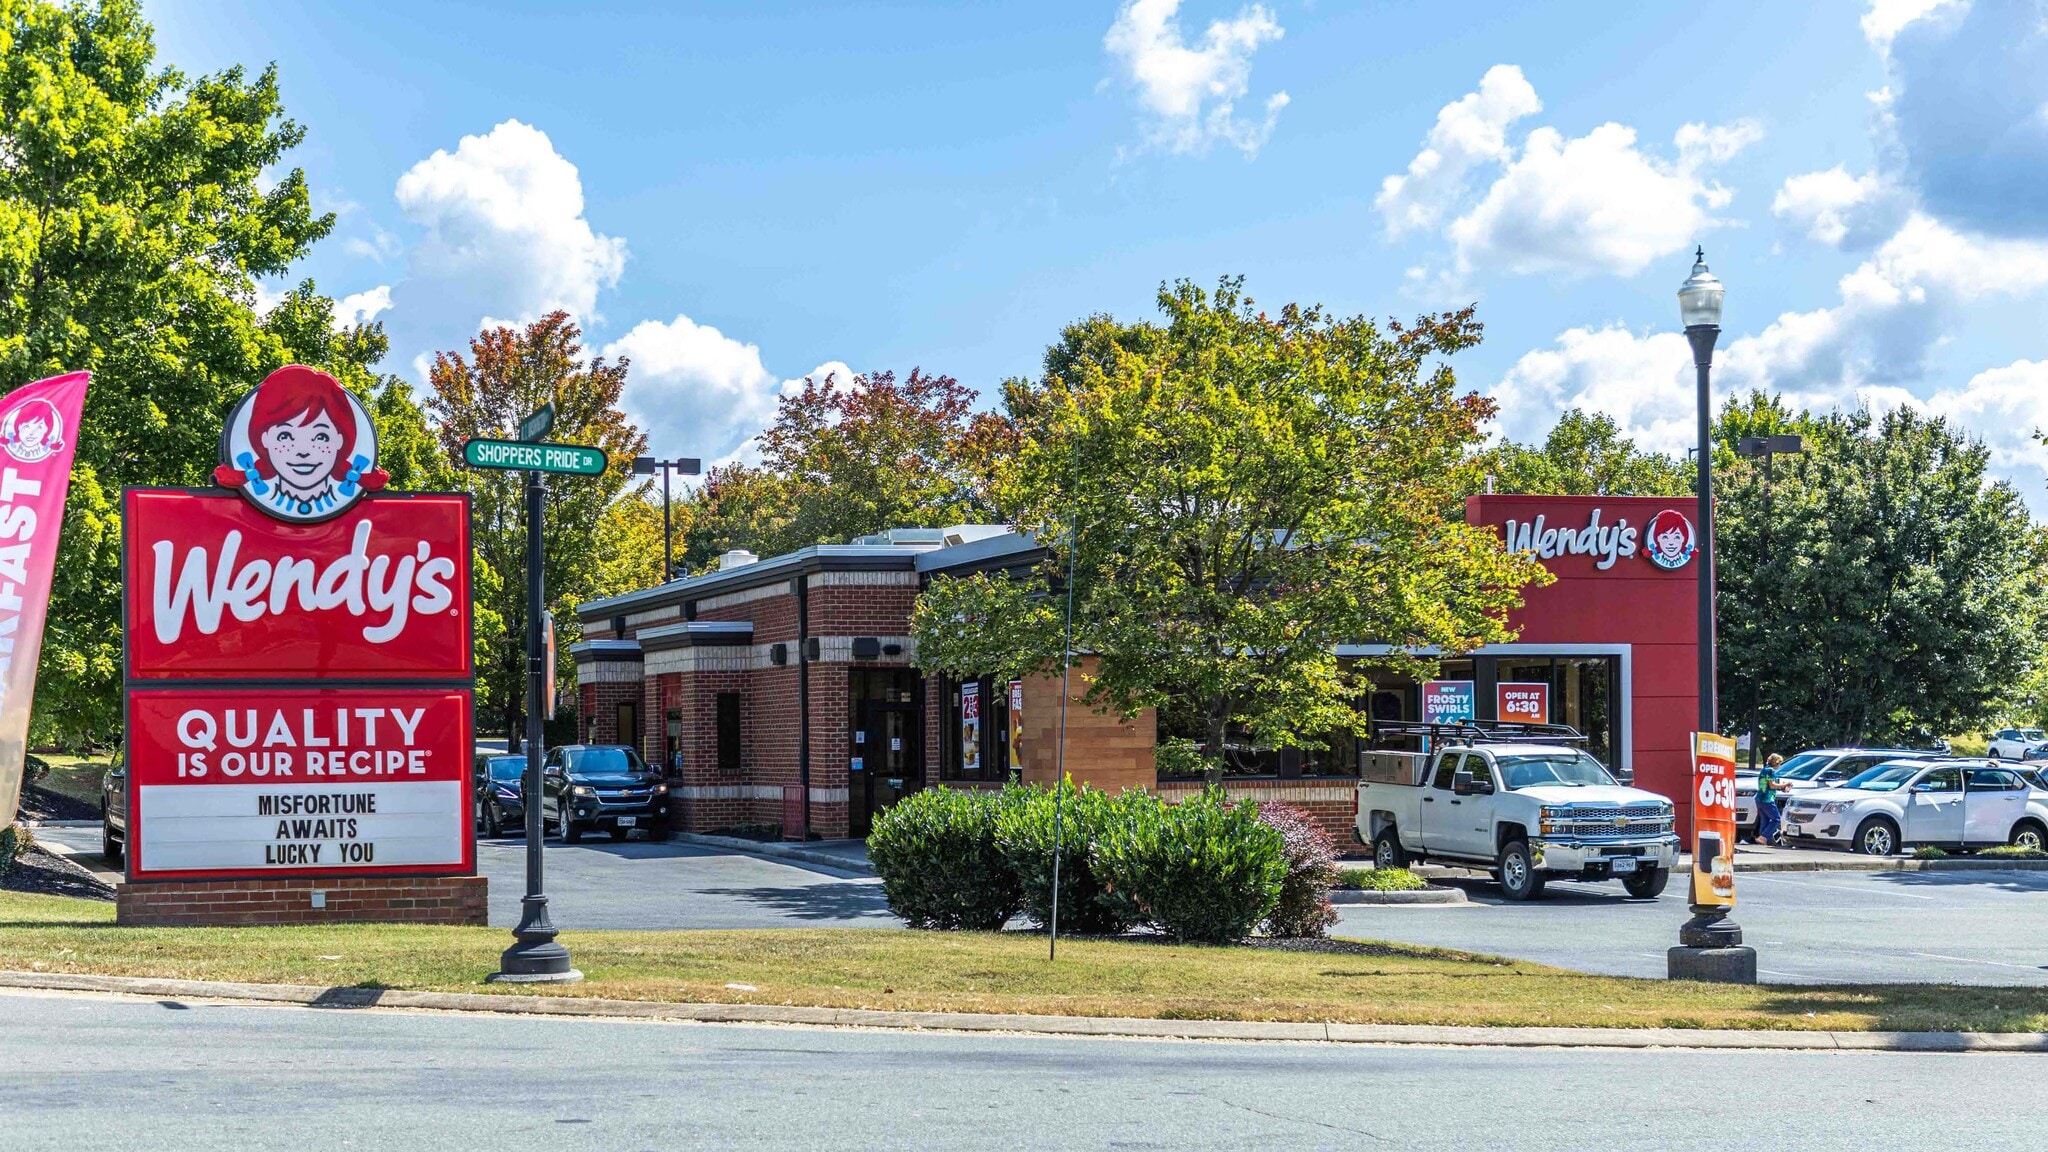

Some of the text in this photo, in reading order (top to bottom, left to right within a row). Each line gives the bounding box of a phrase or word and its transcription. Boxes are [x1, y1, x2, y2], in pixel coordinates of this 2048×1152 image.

[477, 444, 593, 469] SHOPPERS PRIDE DR
[1506, 508, 1637, 570] Wendy's
[152, 519, 455, 644] Wendy's
[1427, 694, 1469, 704] FROSTY
[1505, 692, 1540, 700] OPEN AT
[1506, 700, 1539, 713] 6:30
[1427, 704, 1470, 714] SWIRLS
[177, 708, 426, 752] QUALITY
[178, 752, 208, 778] IS
[220, 752, 293, 777] OUR
[1699, 763, 1718, 774] OPEN
[1699, 775, 1735, 810] 6:30
[258, 793, 376, 815] MISFORTUNE
[276, 818, 357, 839] AWAITS
[266, 842, 374, 865] LUCKY YOU
